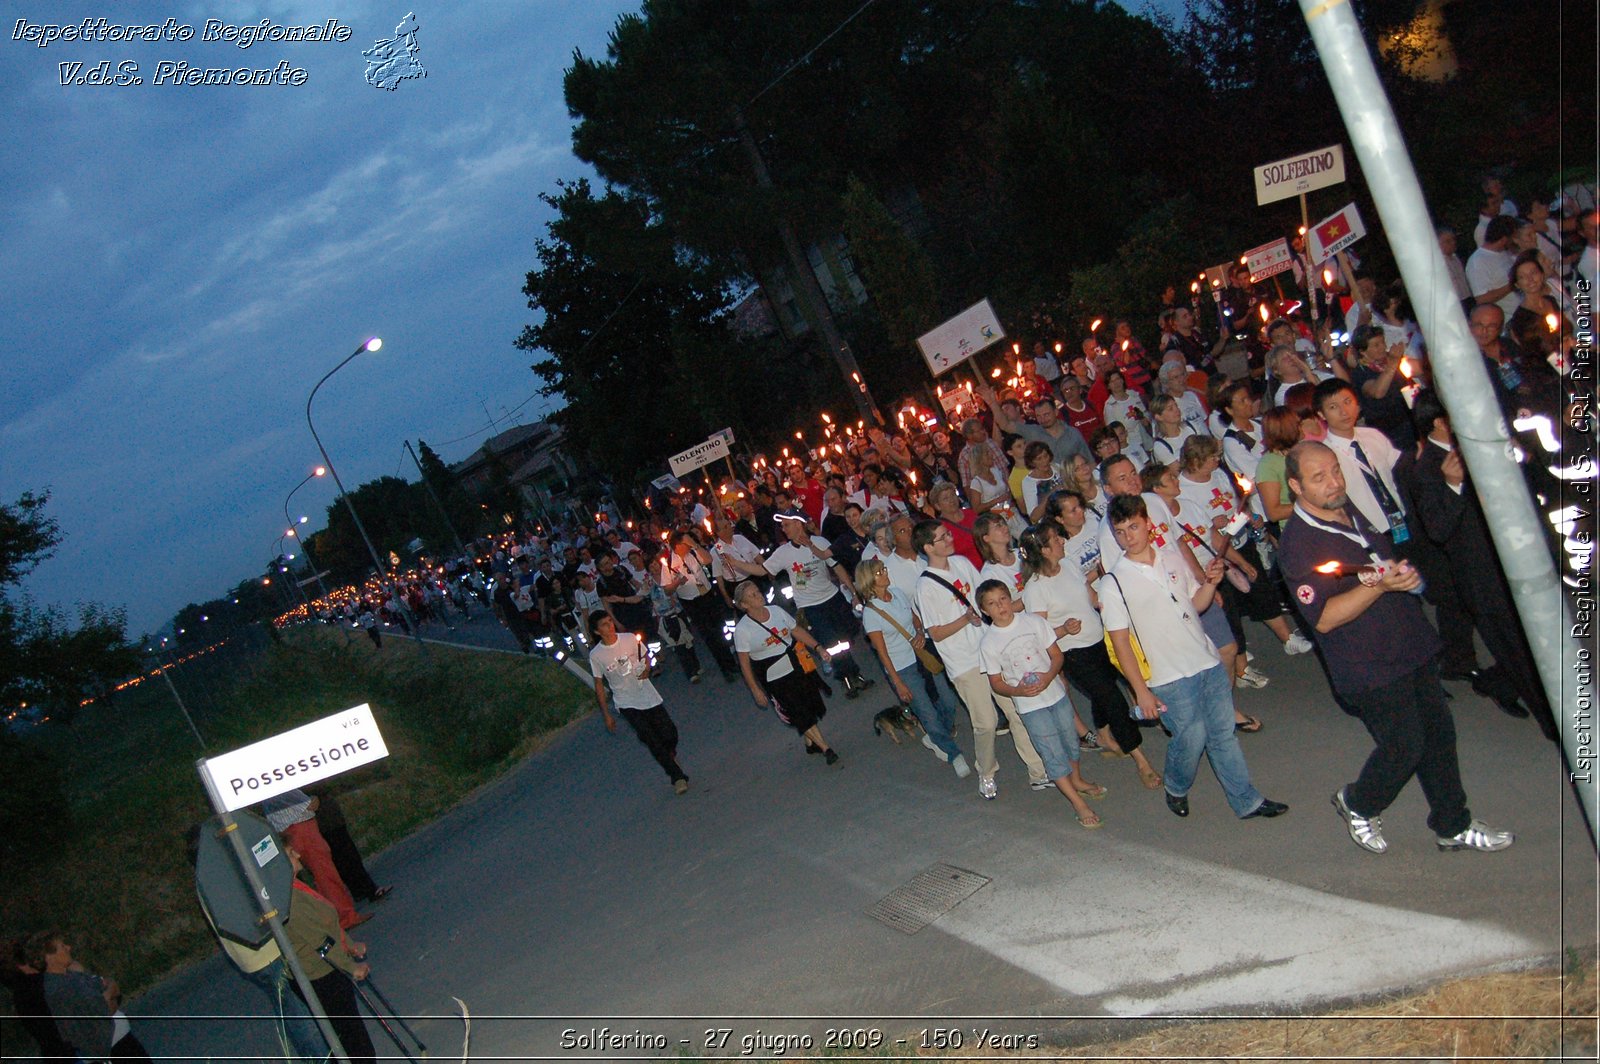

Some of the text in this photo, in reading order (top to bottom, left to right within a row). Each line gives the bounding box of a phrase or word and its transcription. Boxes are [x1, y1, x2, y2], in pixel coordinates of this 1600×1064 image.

[1263, 151, 1334, 187] SOLFERINO
[1253, 260, 1290, 279] NOVARA
[674, 439, 721, 464] TOLENTINO
[341, 716, 361, 730] via
[230, 737, 370, 795] Possessione
